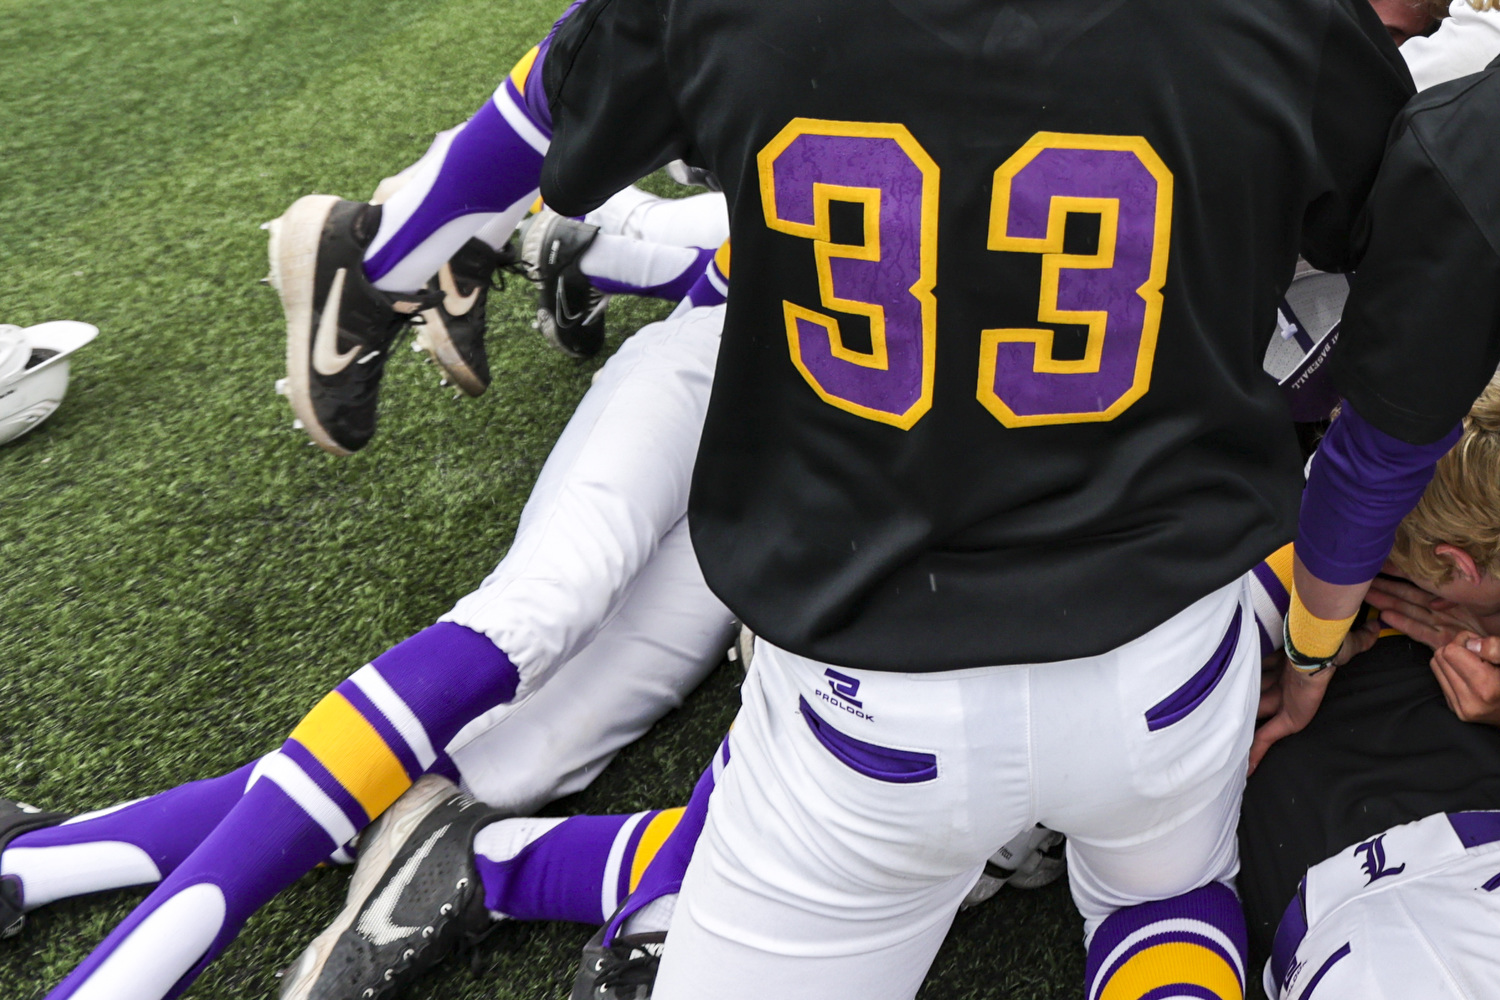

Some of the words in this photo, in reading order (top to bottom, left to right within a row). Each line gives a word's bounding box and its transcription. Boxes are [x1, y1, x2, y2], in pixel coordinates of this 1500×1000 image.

[756, 117, 1174, 431] 33
[1291, 342, 1332, 390] BASEBALL
[815, 688, 875, 723] PROLOOK
[1353, 832, 1406, 889] L
